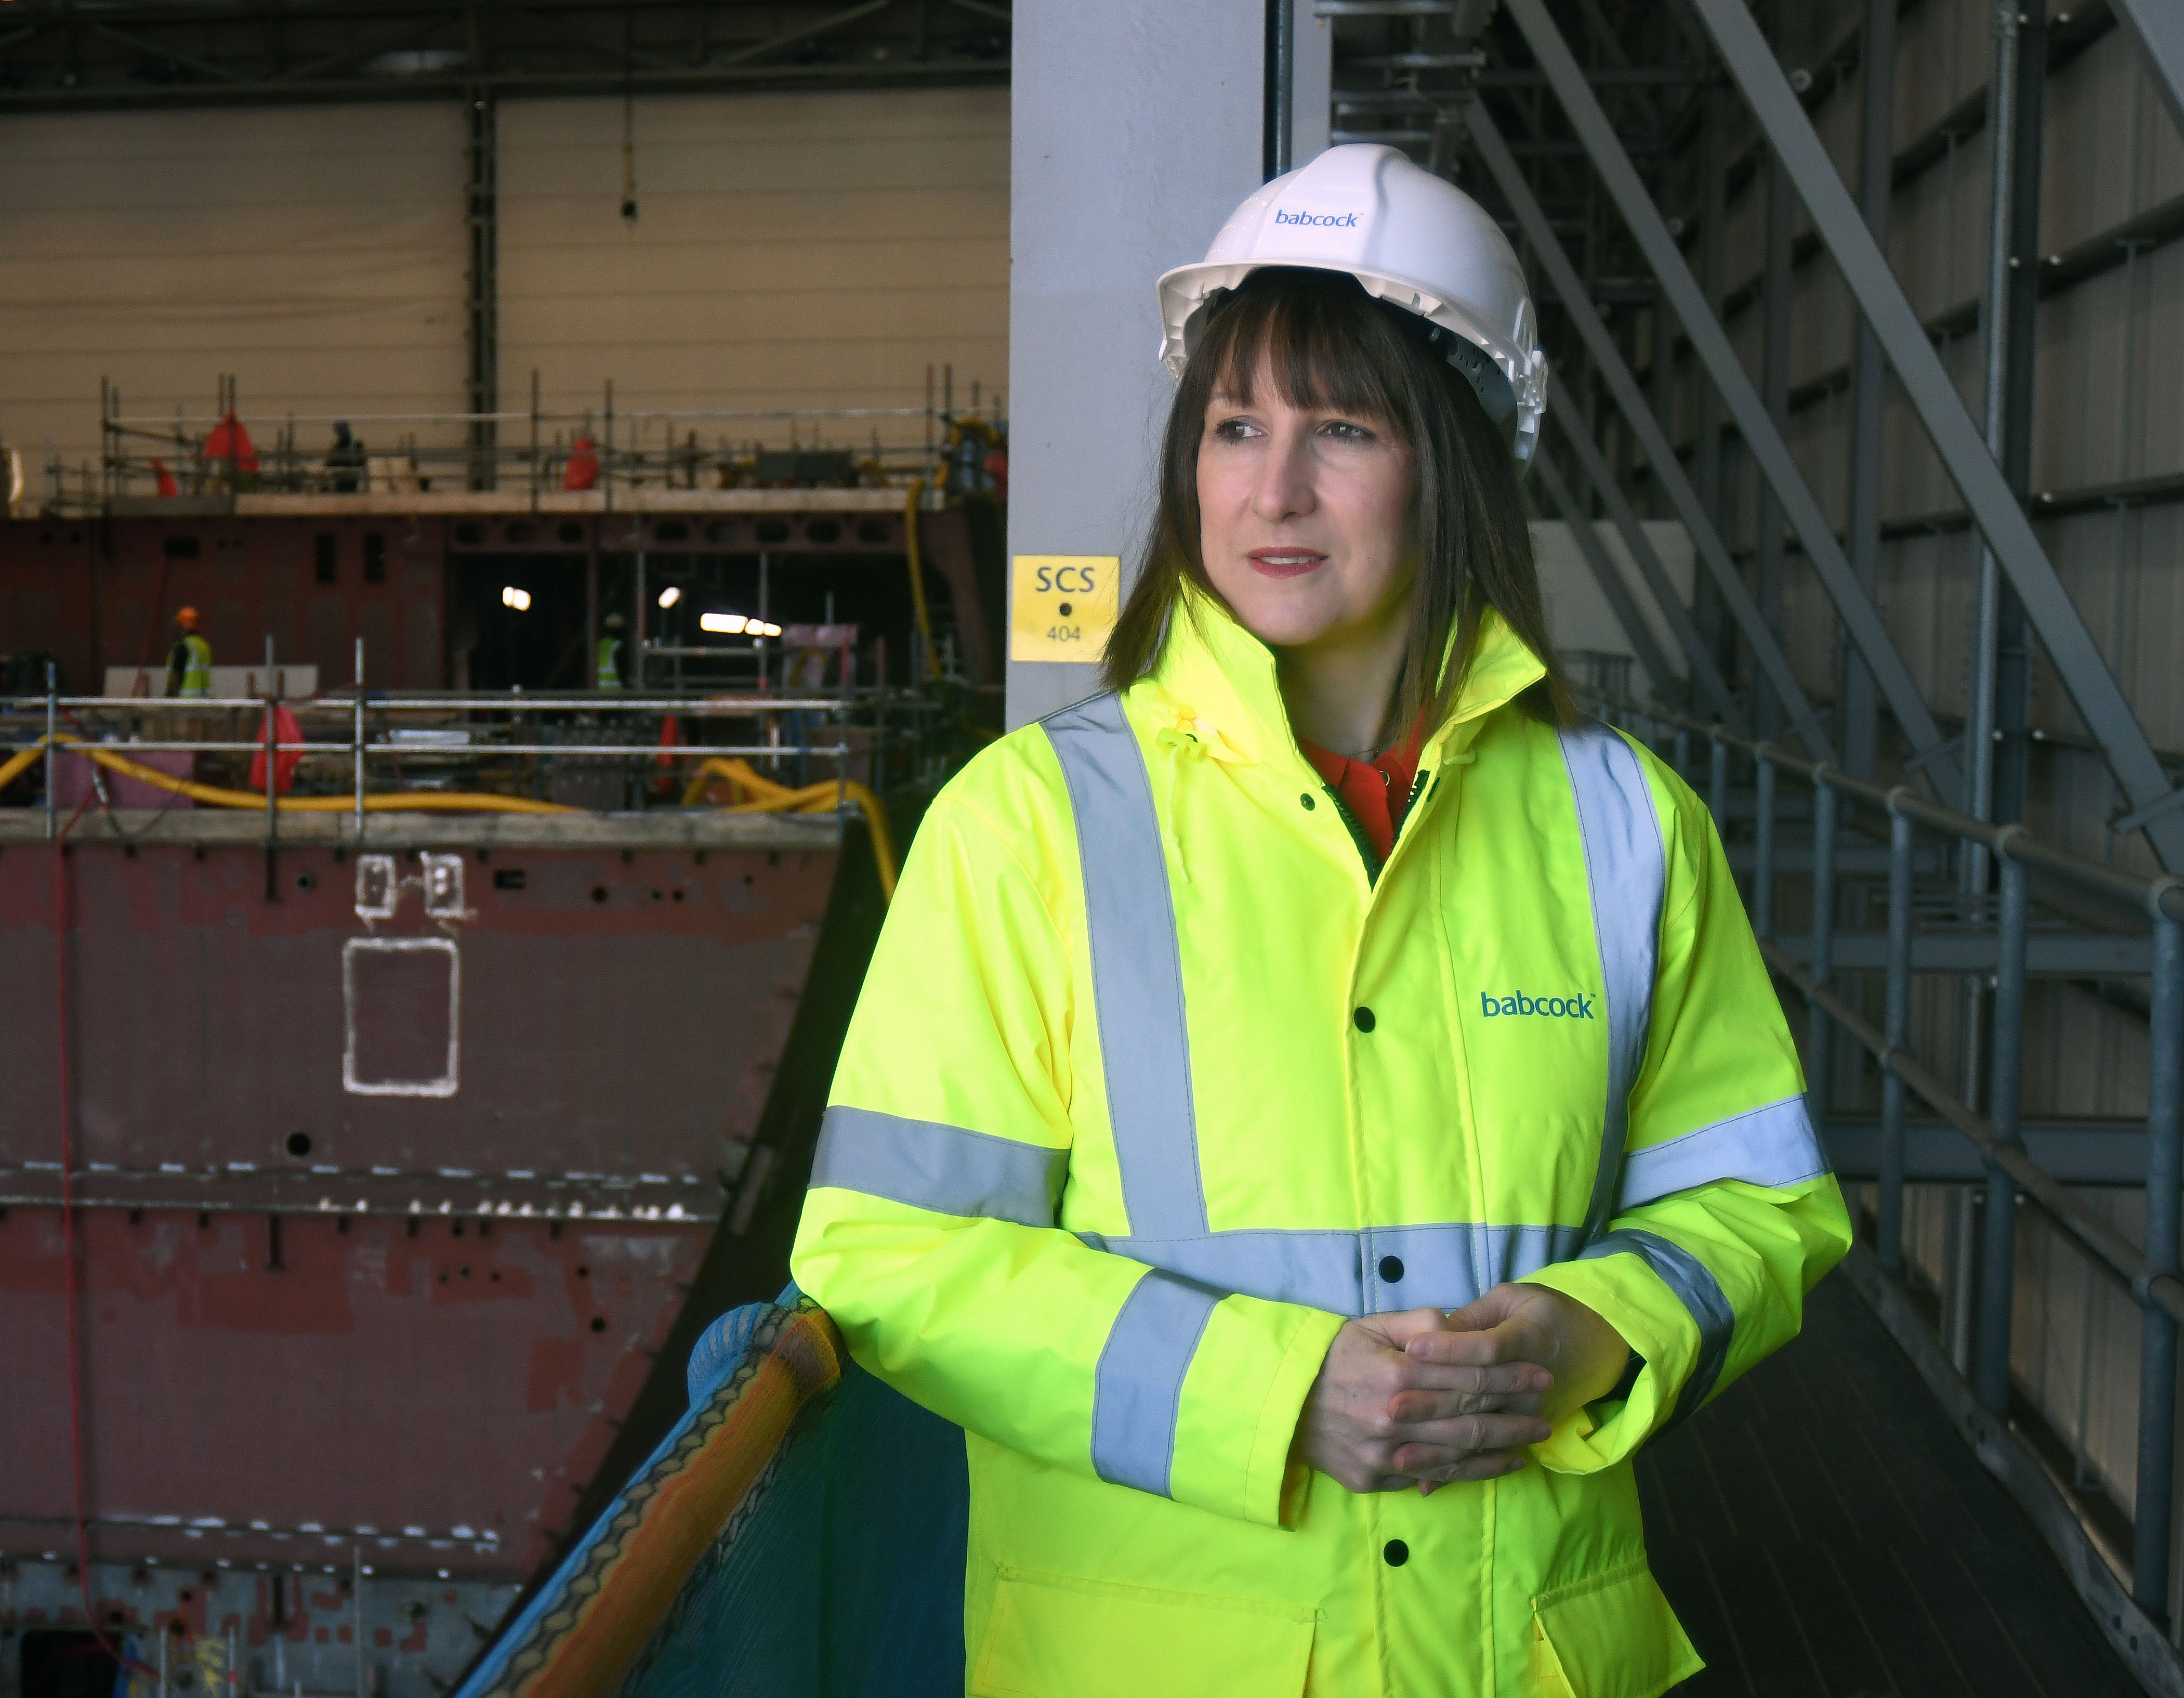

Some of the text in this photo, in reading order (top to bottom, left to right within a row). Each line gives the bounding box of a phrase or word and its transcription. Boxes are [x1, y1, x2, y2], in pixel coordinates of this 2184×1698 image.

[1274, 210, 1359, 227] babcock
[1035, 566, 1094, 592] SCS
[1046, 625, 1081, 642] 404
[1480, 990, 1594, 1020] babcock
